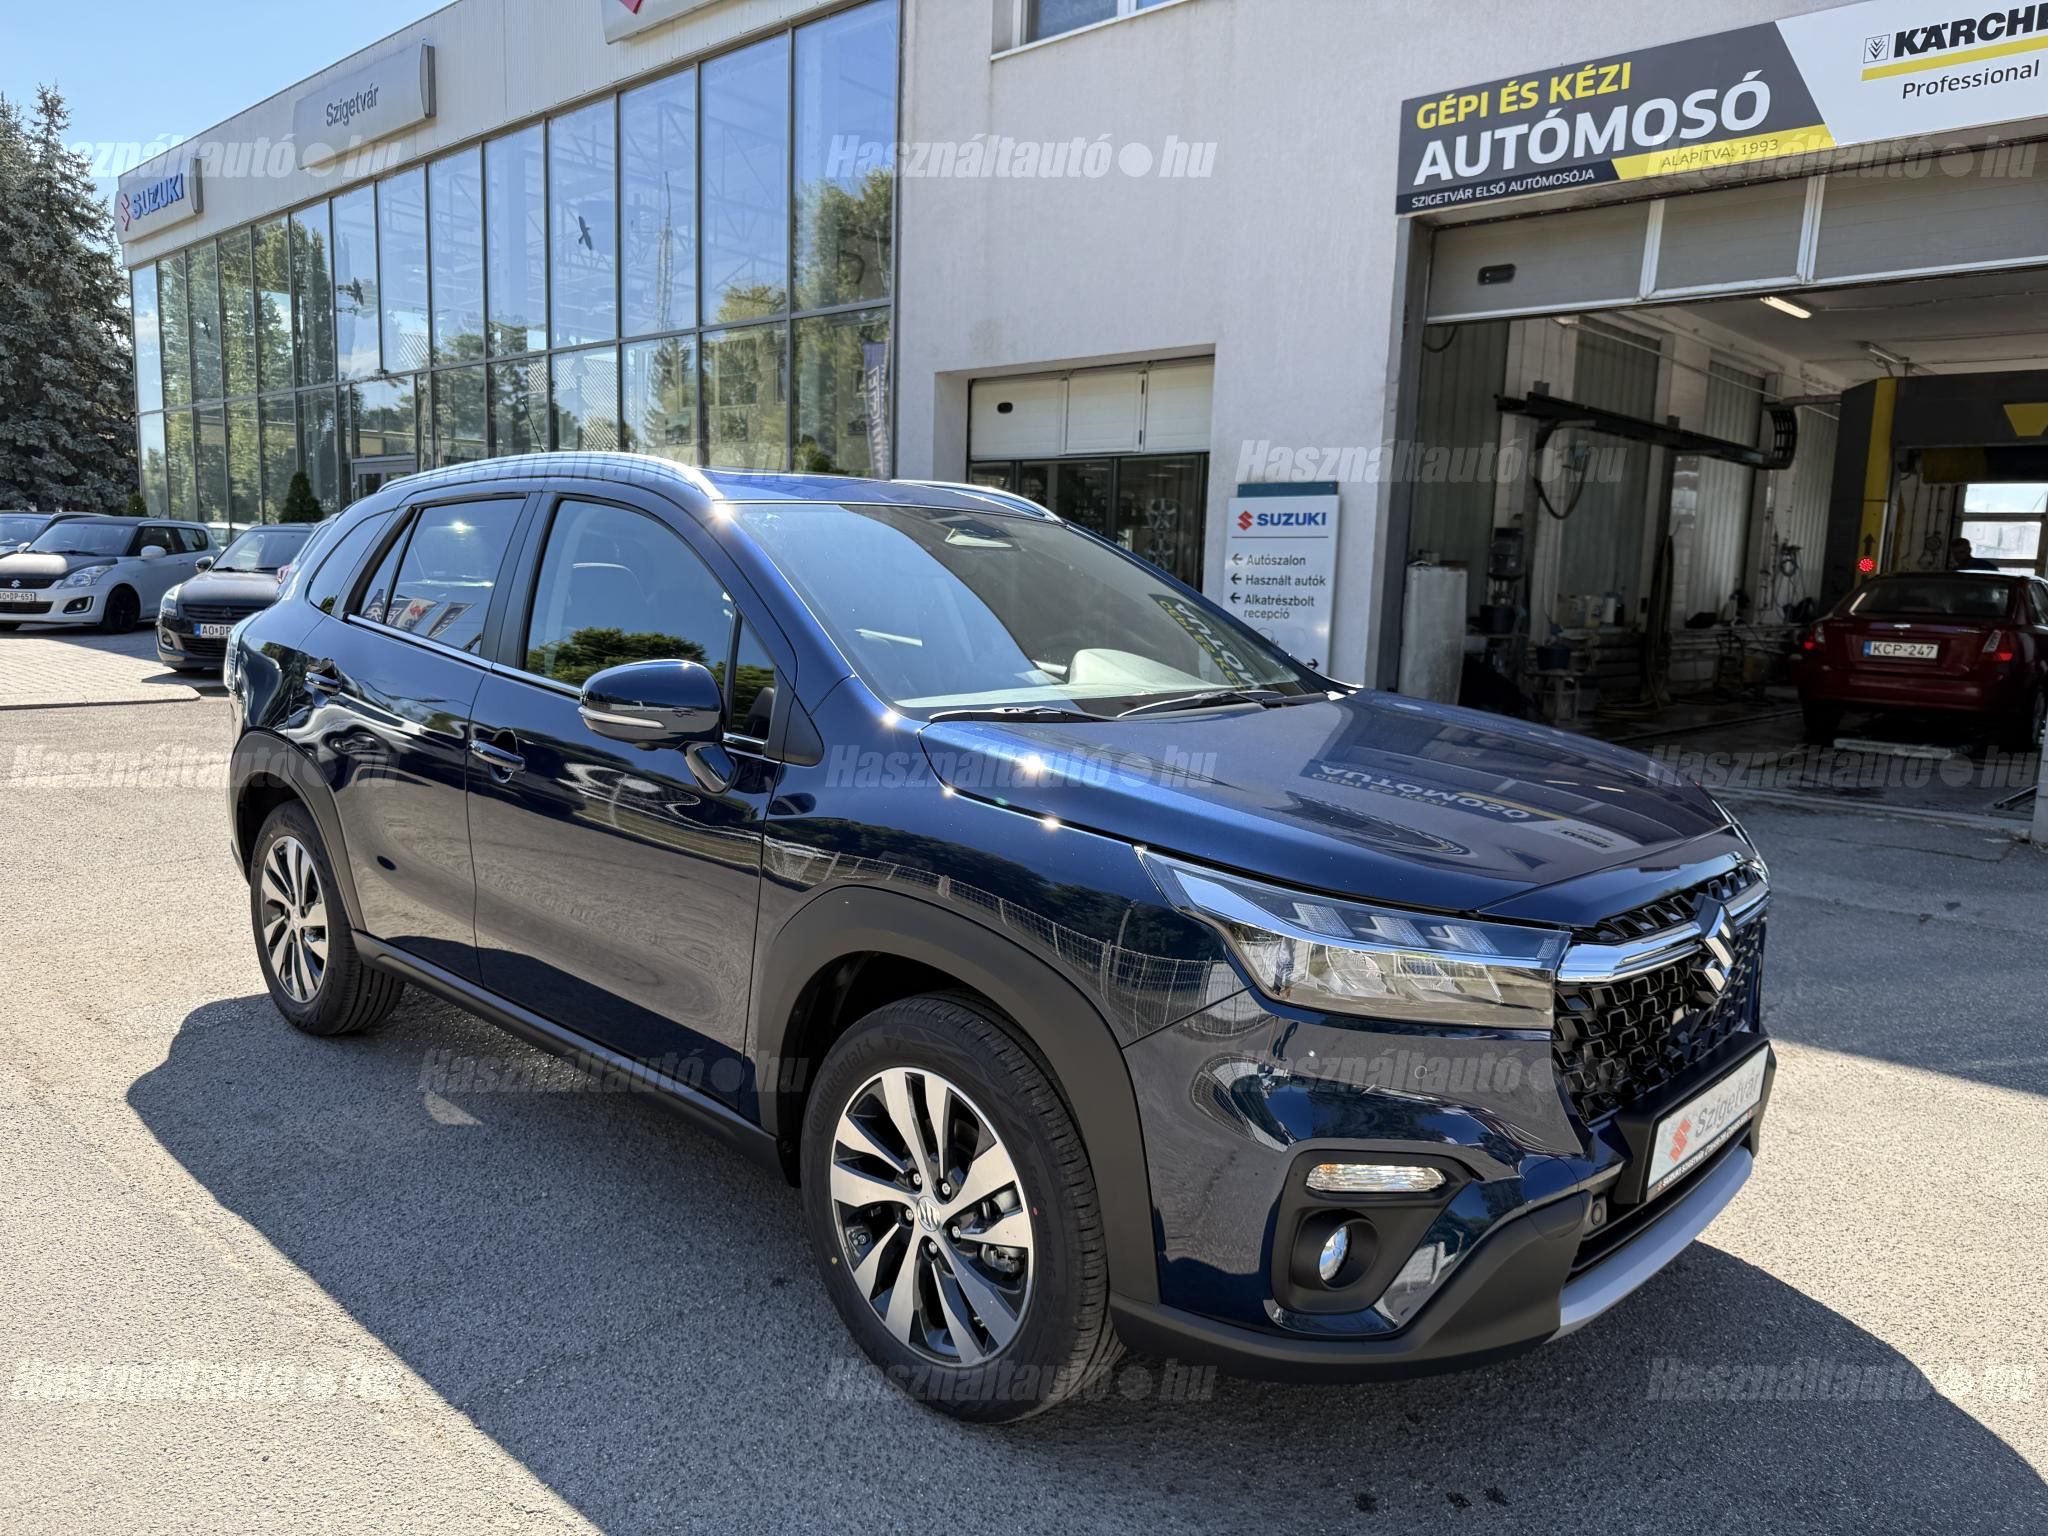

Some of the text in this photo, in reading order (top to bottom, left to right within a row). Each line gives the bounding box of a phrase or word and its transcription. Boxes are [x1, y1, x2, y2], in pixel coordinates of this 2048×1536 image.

[1902, 59, 2040, 100] Professional
[326, 83, 379, 127] Szigetvár
[1416, 61, 1632, 130] GÉPI ÉS KÉZI
[1412, 69, 1772, 186] AUTÓMOSÓ
[1741, 138, 1779, 156] 1993
[131, 173, 185, 221] SUZUKI
[1411, 168, 1595, 208] SZIGETVÁR ELSŐ AUTÓMOSÓJA
[1256, 511, 1327, 527] SUZUKI
[1246, 553, 1306, 566] Autószalon
[1245, 574, 1326, 587] Használt autók
[1243, 594, 1315, 607] Alkatrészbolt
[1243, 608, 1290, 621] recepció
[1873, 642, 1934, 657] KCP-247
[1695, 1070, 1760, 1138] Szigetvár
